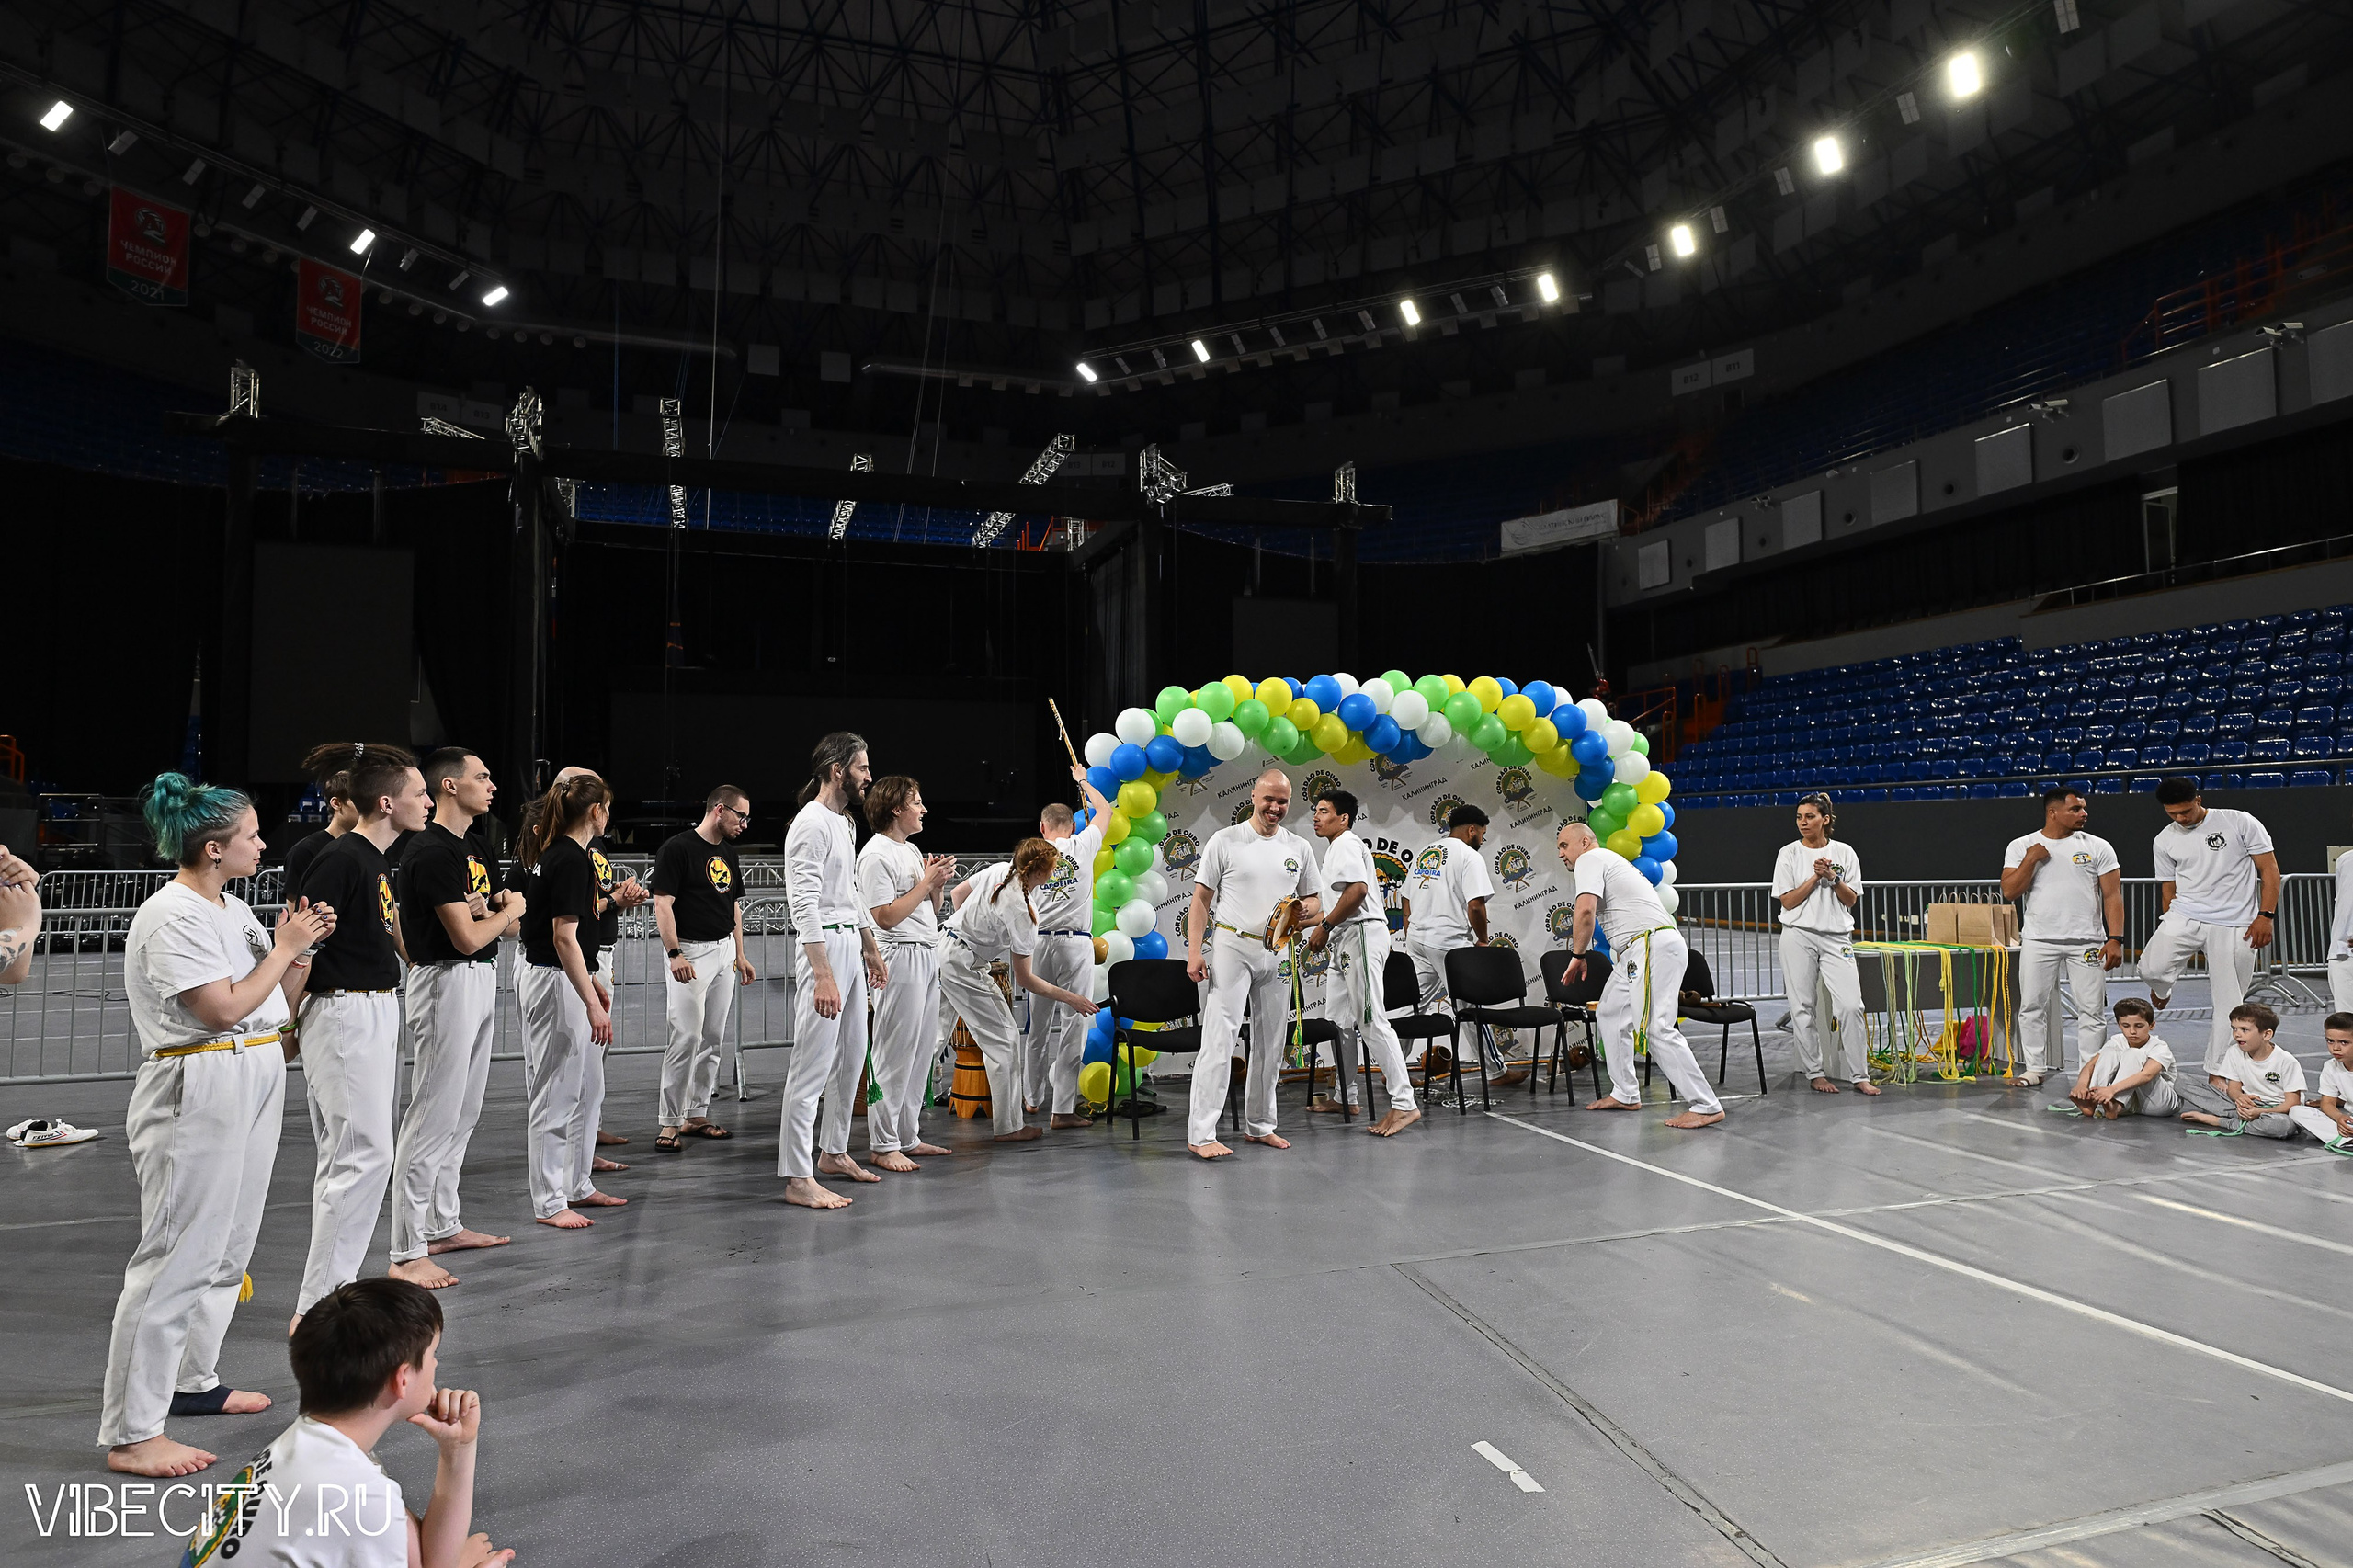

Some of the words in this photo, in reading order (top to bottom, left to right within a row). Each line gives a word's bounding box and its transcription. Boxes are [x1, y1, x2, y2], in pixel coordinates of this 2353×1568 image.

[120, 239, 177, 267] ЧЕМПИОН
[131, 279, 165, 301] 2021
[306, 305, 352, 329] ЧЕМПИОН
[1325, 770, 1342, 787] OURO
[1402, 777, 1448, 801] КАЛИНИНГРАД
[1509, 805, 1553, 829] КАЛИНИНГРАД
[1183, 830, 1200, 846] OURO
[1377, 837, 1399, 854] DE
[1517, 845, 1531, 860] OURO
[1514, 885, 1558, 910] КАЛИНИНГРАД
[1504, 932, 1519, 949] OURO
